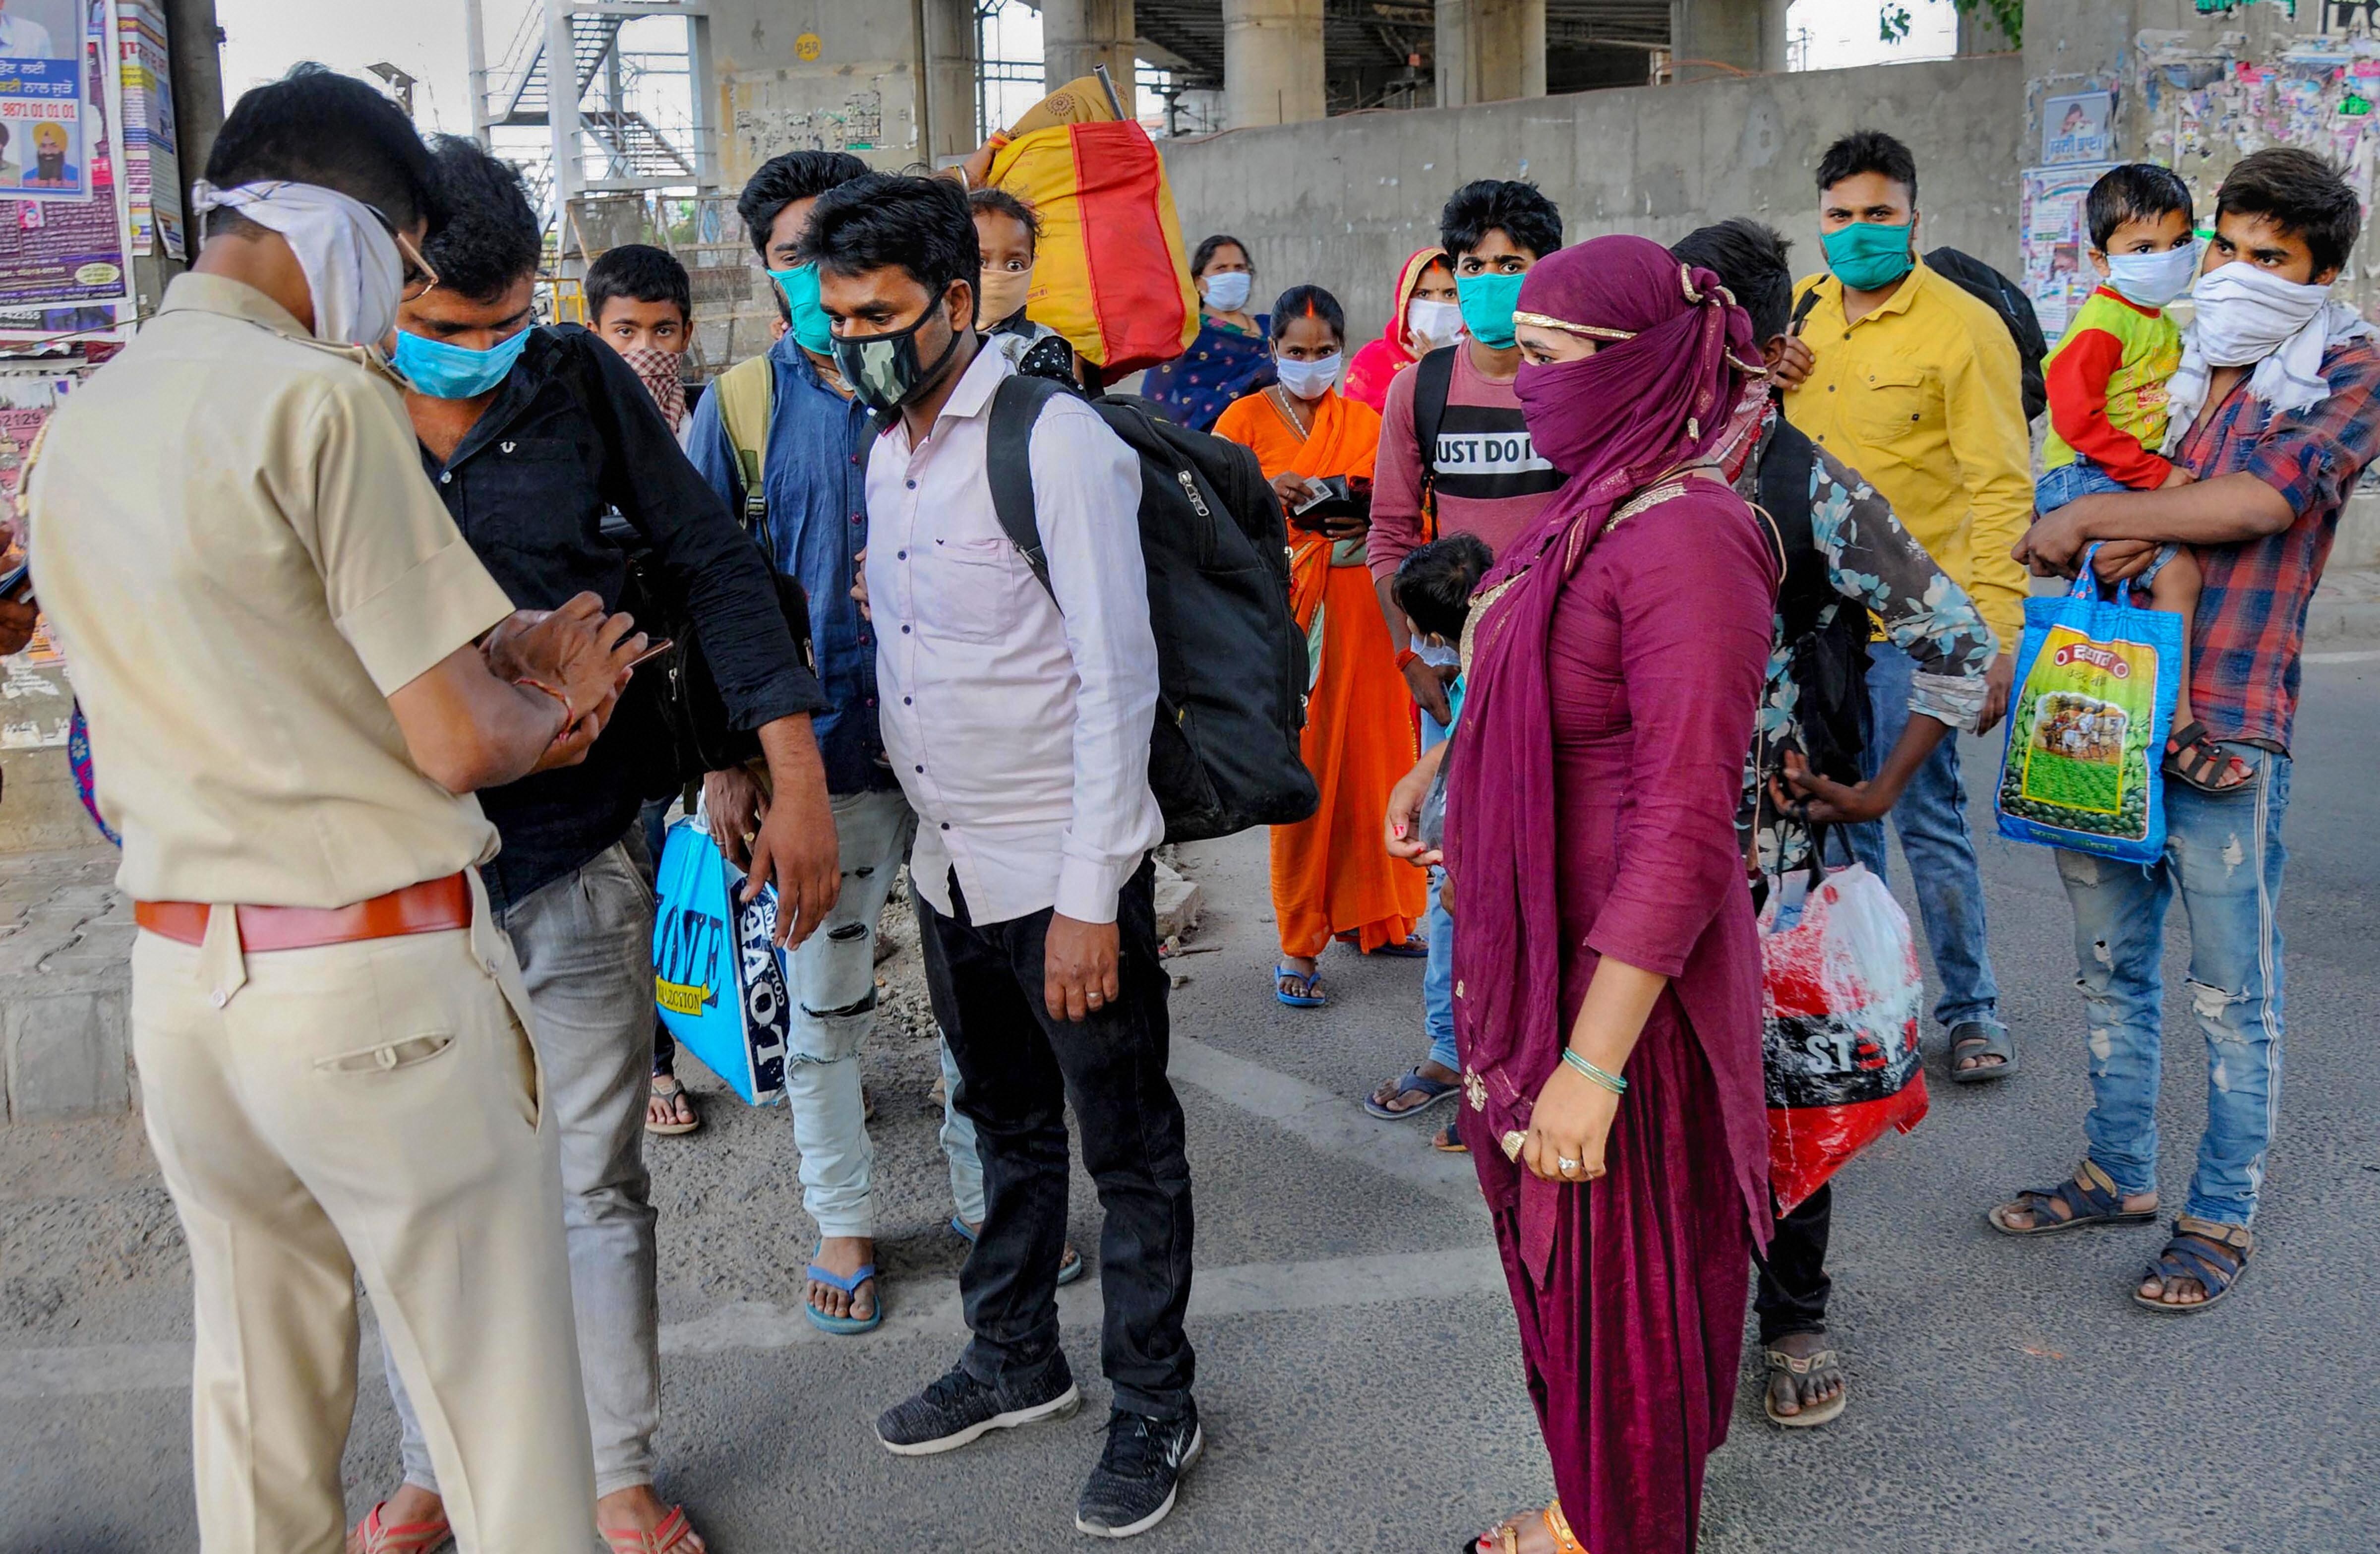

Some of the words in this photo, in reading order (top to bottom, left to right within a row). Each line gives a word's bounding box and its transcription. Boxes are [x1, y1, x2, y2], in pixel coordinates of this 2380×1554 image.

[3, 102, 28, 117] 9871
[32, 103, 44, 118] 01
[48, 103, 60, 118] 01
[63, 104, 75, 118] 01
[846, 126, 880, 136] WEEK
[1435, 440, 1479, 463] UST
[1486, 439, 1519, 462] DO
[740, 904, 786, 1066] LOVE
